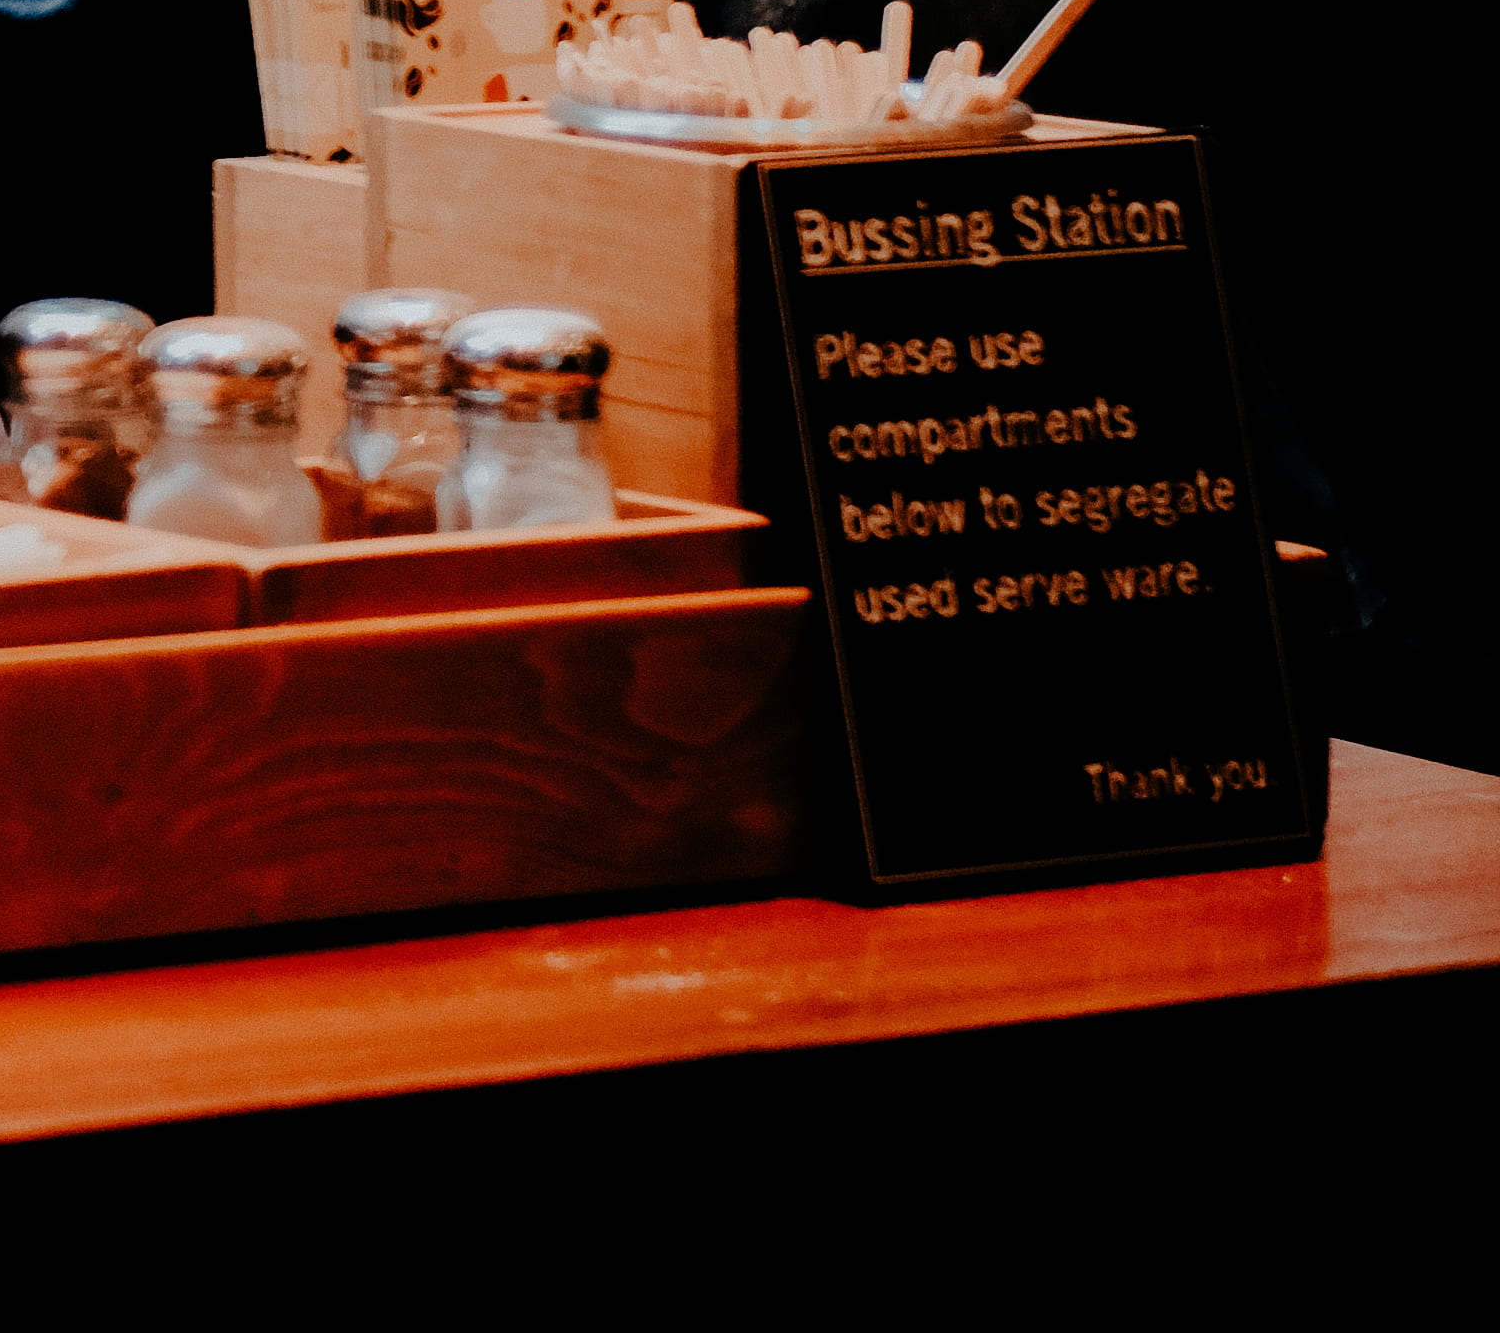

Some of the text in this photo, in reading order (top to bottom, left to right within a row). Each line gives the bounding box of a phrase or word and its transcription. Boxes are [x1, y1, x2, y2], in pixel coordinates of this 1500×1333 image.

[795, 187, 1184, 268] Bussing Station
[814, 329, 1046, 380] Please use
[828, 395, 1138, 466] compartments
[839, 469, 1236, 544] below to segregate
[854, 569, 960, 623] used
[973, 568, 1090, 614] serve
[1083, 757, 1195, 805] Thank
